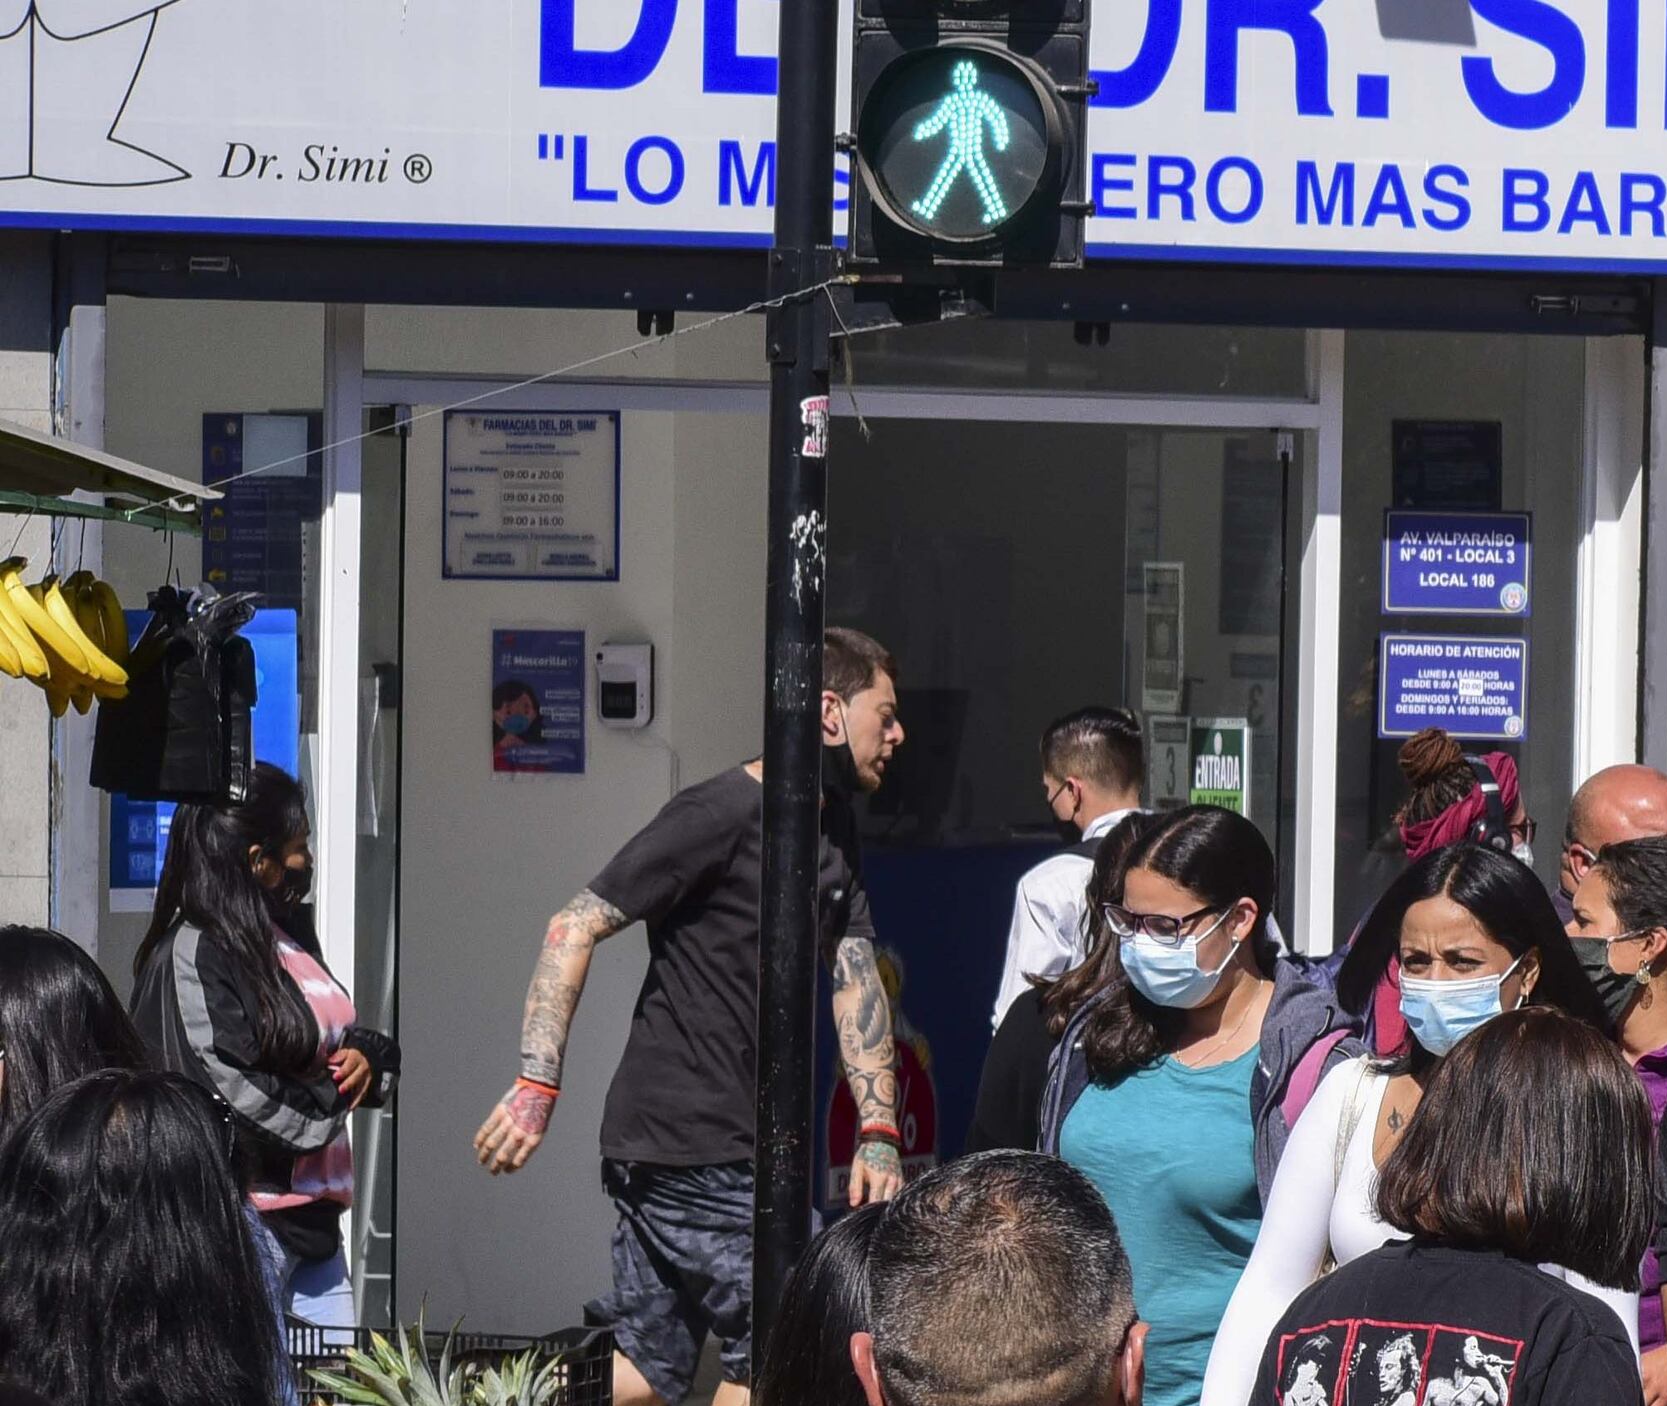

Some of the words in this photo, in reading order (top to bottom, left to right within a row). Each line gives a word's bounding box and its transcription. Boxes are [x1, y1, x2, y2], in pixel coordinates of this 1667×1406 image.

[218, 141, 283, 180] Dr.
[298, 144, 391, 183] Simi
[537, 134, 684, 205] "LO
[1091, 152, 1264, 224] ERO
[1296, 160, 1472, 231] MAS
[483, 419, 537, 431] FARMACIAS
[539, 420, 557, 431] DEL
[560, 420, 575, 432] DR.
[503, 470, 529, 480] 09:00
[538, 470, 564, 480] 20:00
[538, 494, 564, 503] 20:00
[1400, 531, 1422, 545] AV.
[1426, 531, 1515, 547] VALPARAÍSO
[1419, 549, 1442, 562] 401
[1456, 550, 1504, 564] LOCAL
[1507, 551, 1515, 564] 3
[1420, 573, 1468, 587] LOCAL
[1471, 574, 1495, 587] 186
[1391, 644, 1444, 657] HORARIO
[1446, 646, 1462, 657] DE
[1464, 645, 1520, 659] ATENCIÓN
[1418, 669, 1448, 679] LUNES
[1449, 670, 1456, 679] A
[1402, 680, 1431, 689] DESDE
[1484, 682, 1515, 691] HORAS
[1401, 694, 1449, 704] DOMINGOS
[1396, 705, 1426, 714] DESDE
[1482, 707, 1514, 716] HORAS
[1195, 755, 1241, 790] ENTRADA
